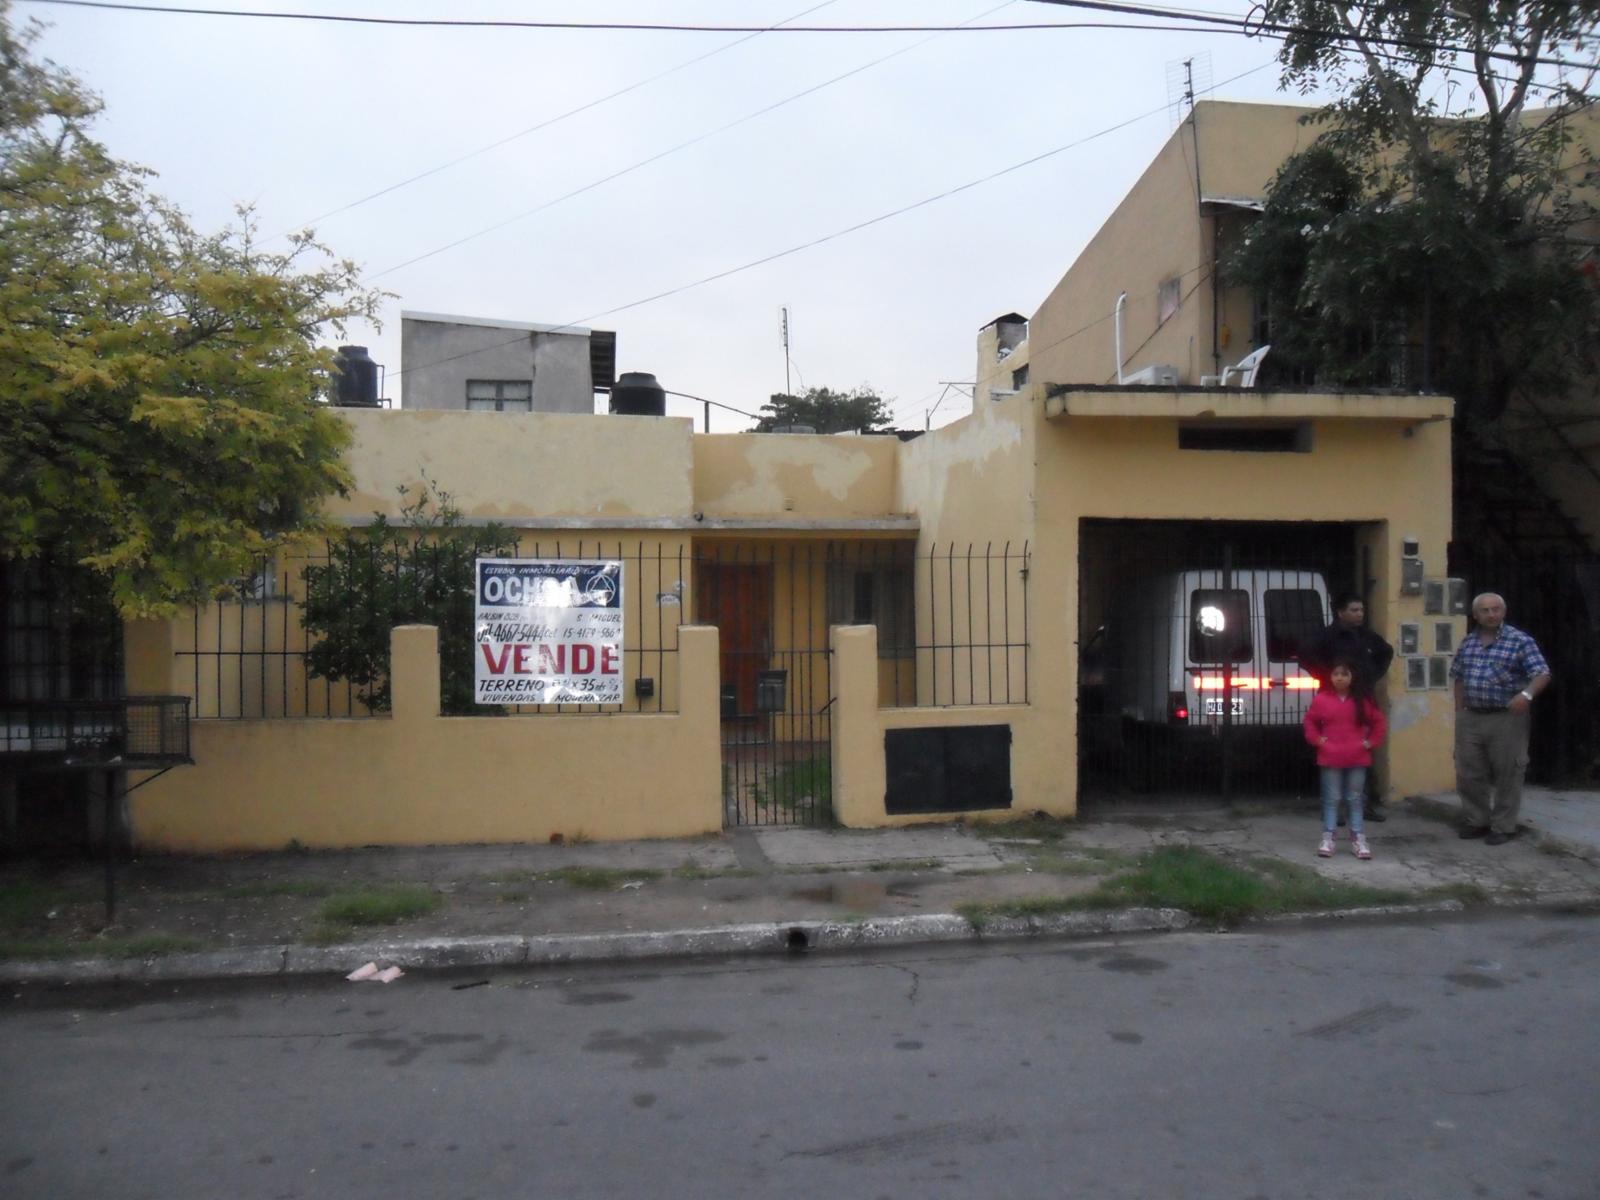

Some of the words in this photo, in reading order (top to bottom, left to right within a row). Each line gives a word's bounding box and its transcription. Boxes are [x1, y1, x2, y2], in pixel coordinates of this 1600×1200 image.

[484, 567, 516, 575] ESTUDIO
[480, 643, 620, 675] VENDE
[479, 679, 545, 692] TERRENO
[579, 678, 597, 692] 35
[481, 693, 536, 703] VIVIENDAS
[554, 692, 621, 703] MODERNZAR
